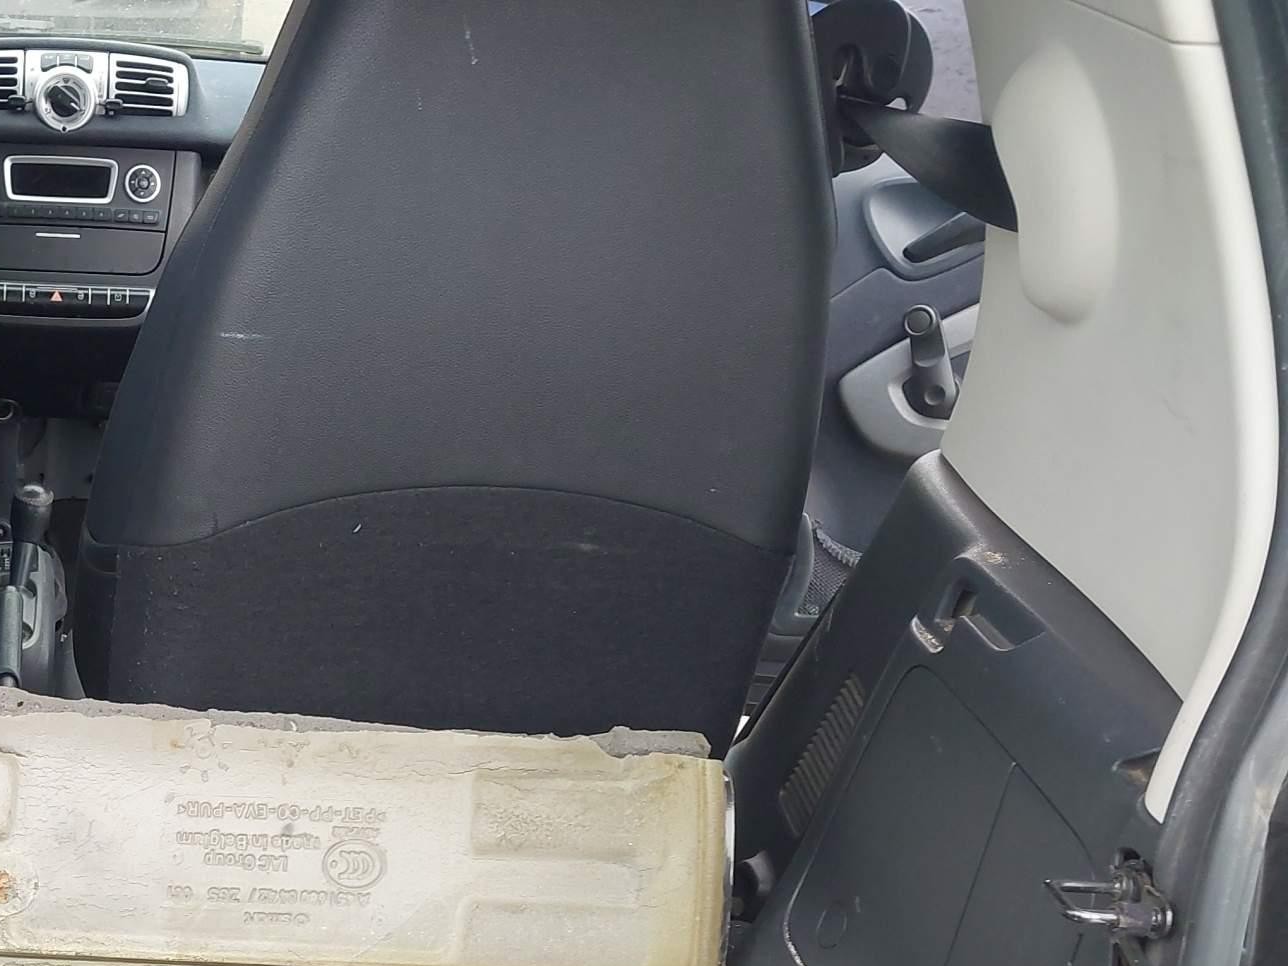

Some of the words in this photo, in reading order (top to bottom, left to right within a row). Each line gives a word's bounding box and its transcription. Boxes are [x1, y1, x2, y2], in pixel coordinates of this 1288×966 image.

[176, 829, 249, 851] Belgium
[252, 833, 269, 851] in
[203, 852, 256, 872] Group
